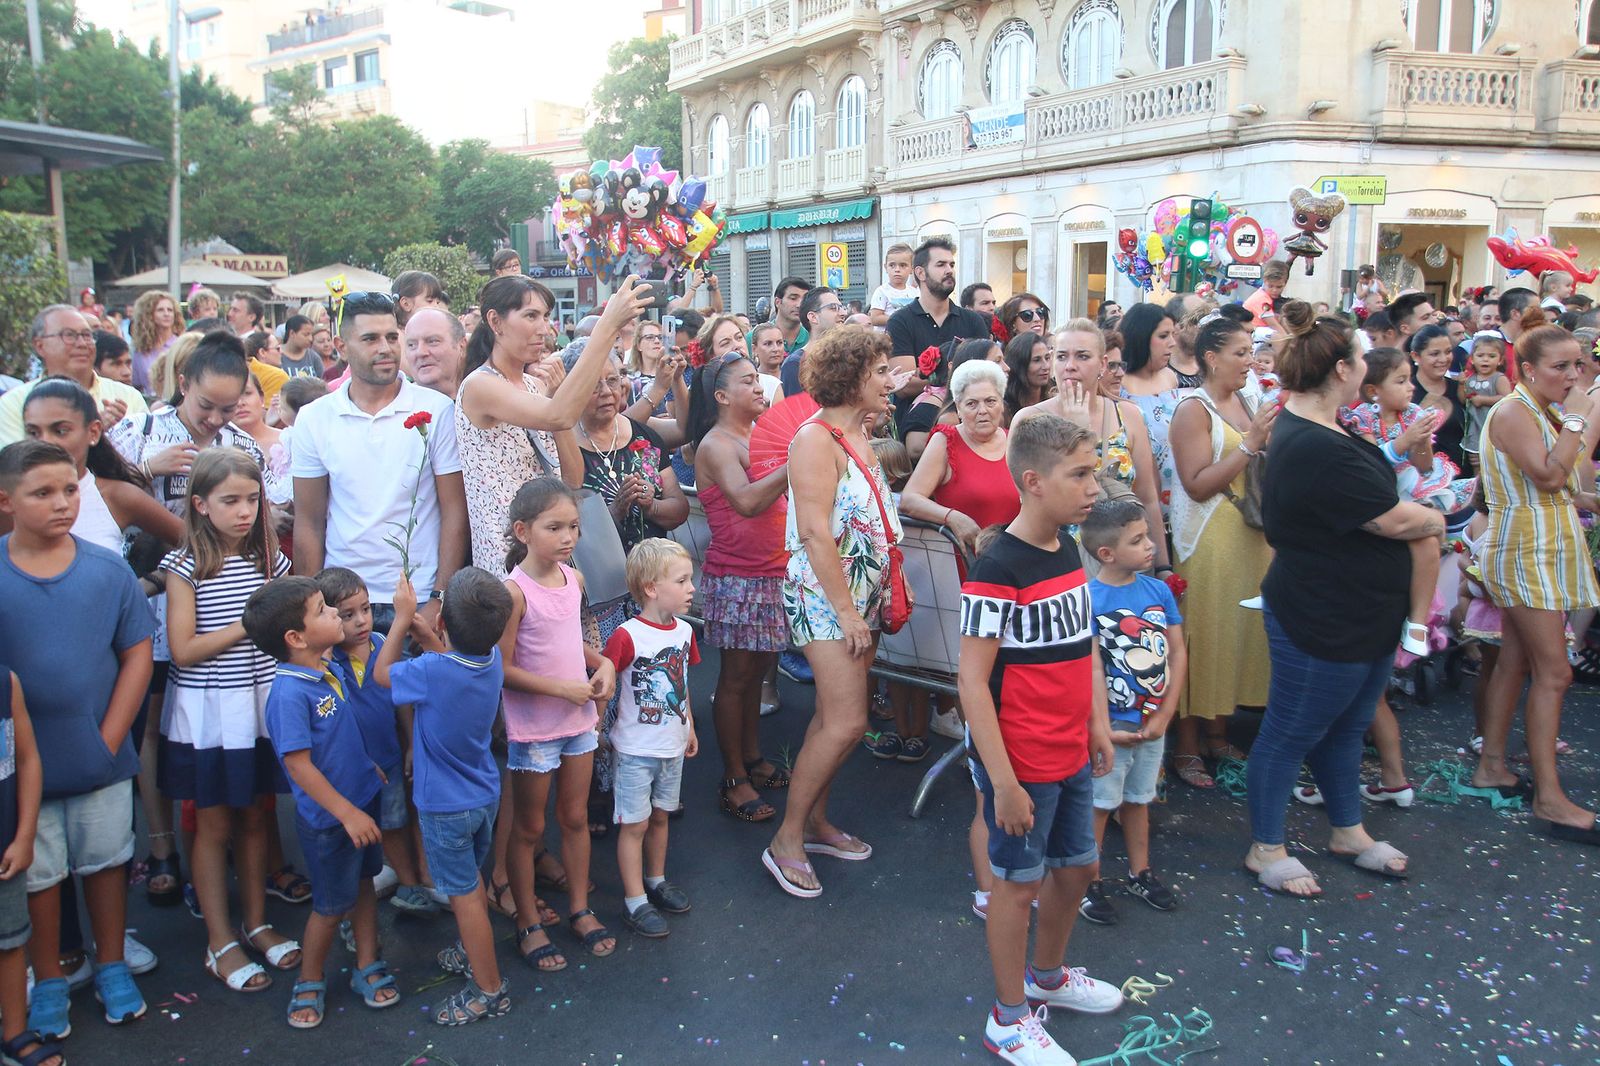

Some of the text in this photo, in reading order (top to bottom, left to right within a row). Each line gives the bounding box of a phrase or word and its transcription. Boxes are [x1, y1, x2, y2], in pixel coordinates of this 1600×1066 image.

[977, 117, 1009, 133] VENDE
[1001, 128, 1012, 140] 967
[1407, 208, 1467, 218] PRONOVIAS
[829, 250, 840, 258] 30
[550, 267, 590, 277] ORBRA
